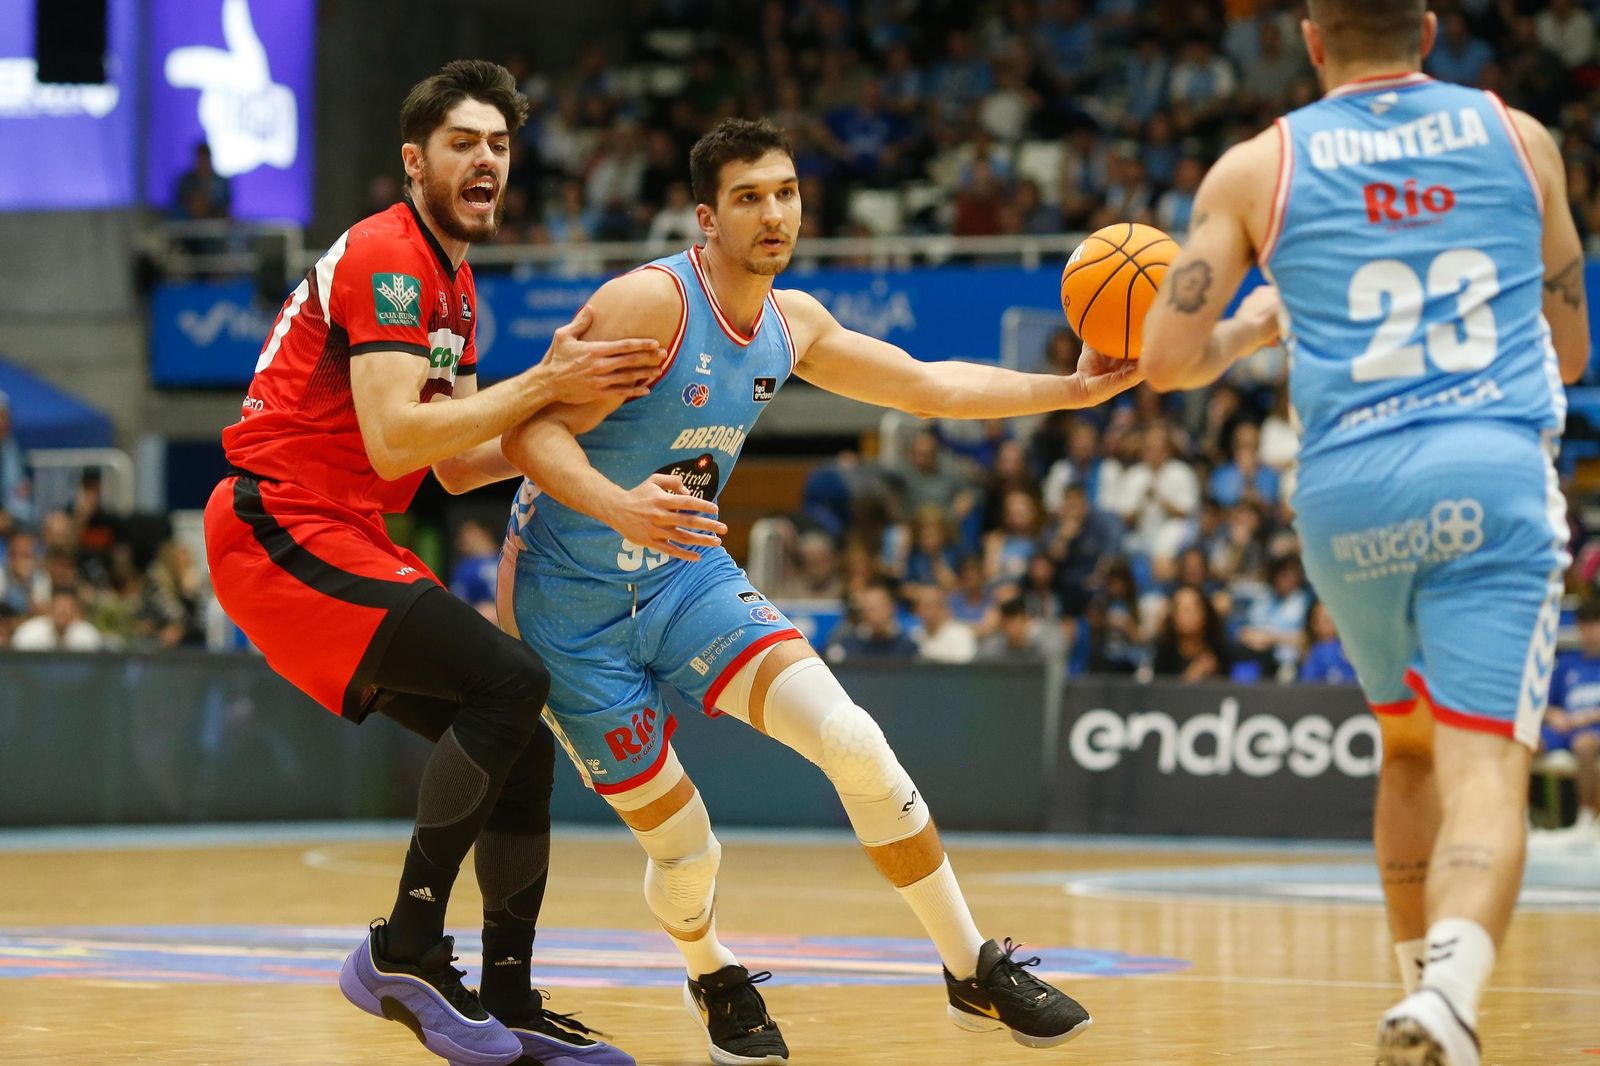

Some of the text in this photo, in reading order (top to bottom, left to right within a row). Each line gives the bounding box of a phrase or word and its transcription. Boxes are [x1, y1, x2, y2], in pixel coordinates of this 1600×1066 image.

[1310, 107, 1489, 171] QUINTELA
[1362, 179, 1456, 224] Río
[1349, 248, 1500, 382] 23
[715, 628, 745, 655] GALICIA
[1068, 696, 1382, 778] endesa
